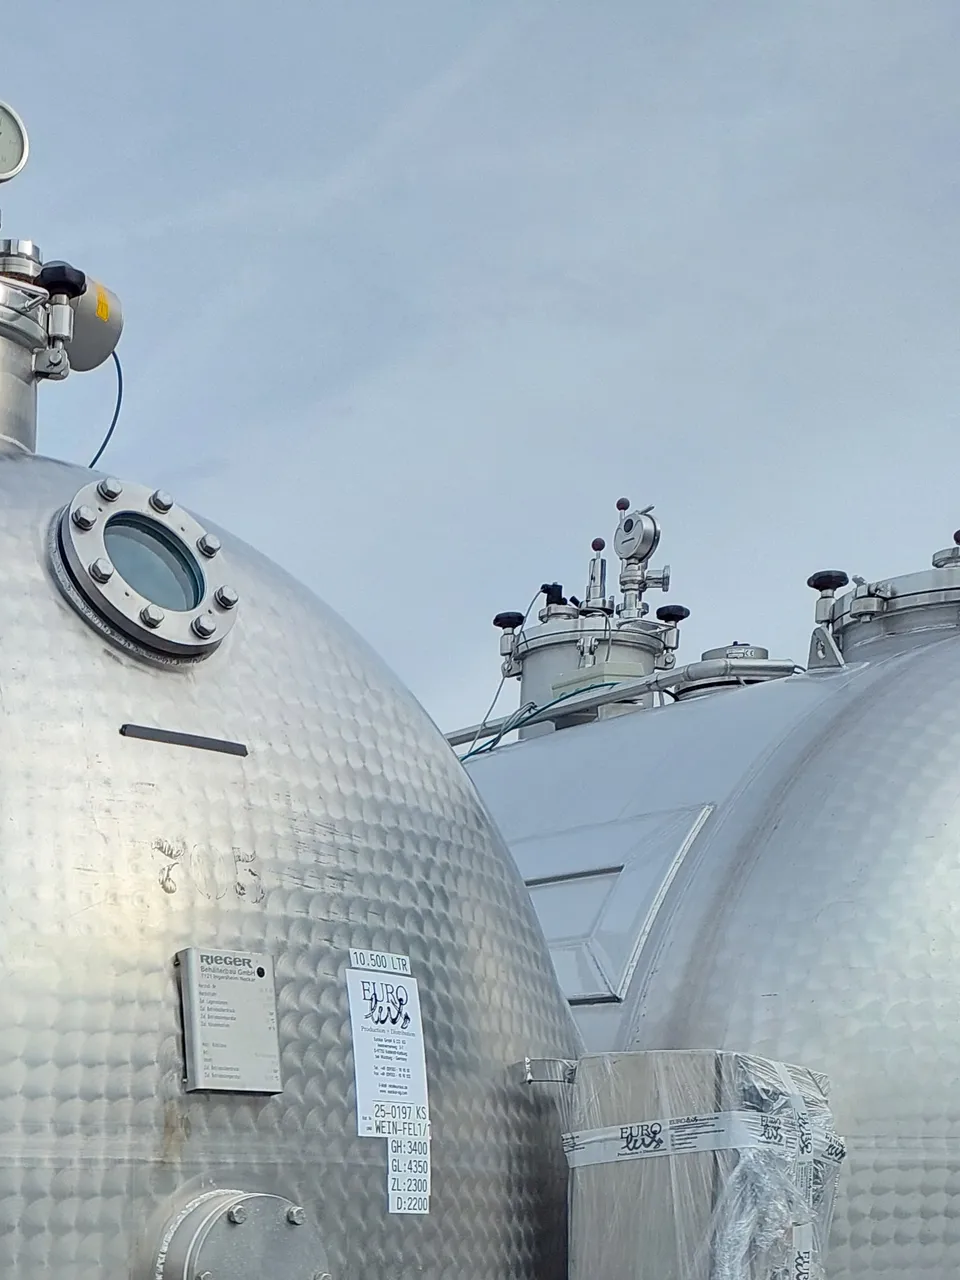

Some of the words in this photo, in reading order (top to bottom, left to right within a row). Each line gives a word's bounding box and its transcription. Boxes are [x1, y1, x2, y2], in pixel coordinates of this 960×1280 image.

[353, 951, 387, 969] 10.500
[391, 956, 408, 972] LTR
[360, 980, 409, 1006] EURO
[374, 1103, 412, 1120] 25-0197
[415, 1105, 427, 1120] KS
[620, 1122, 662, 1139] EURO
[391, 1139, 428, 1156] GH:3400
[391, 1158, 428, 1174] GL:4350
[391, 1177, 428, 1193] ZL:2300
[396, 1196, 428, 1211] D:2200
